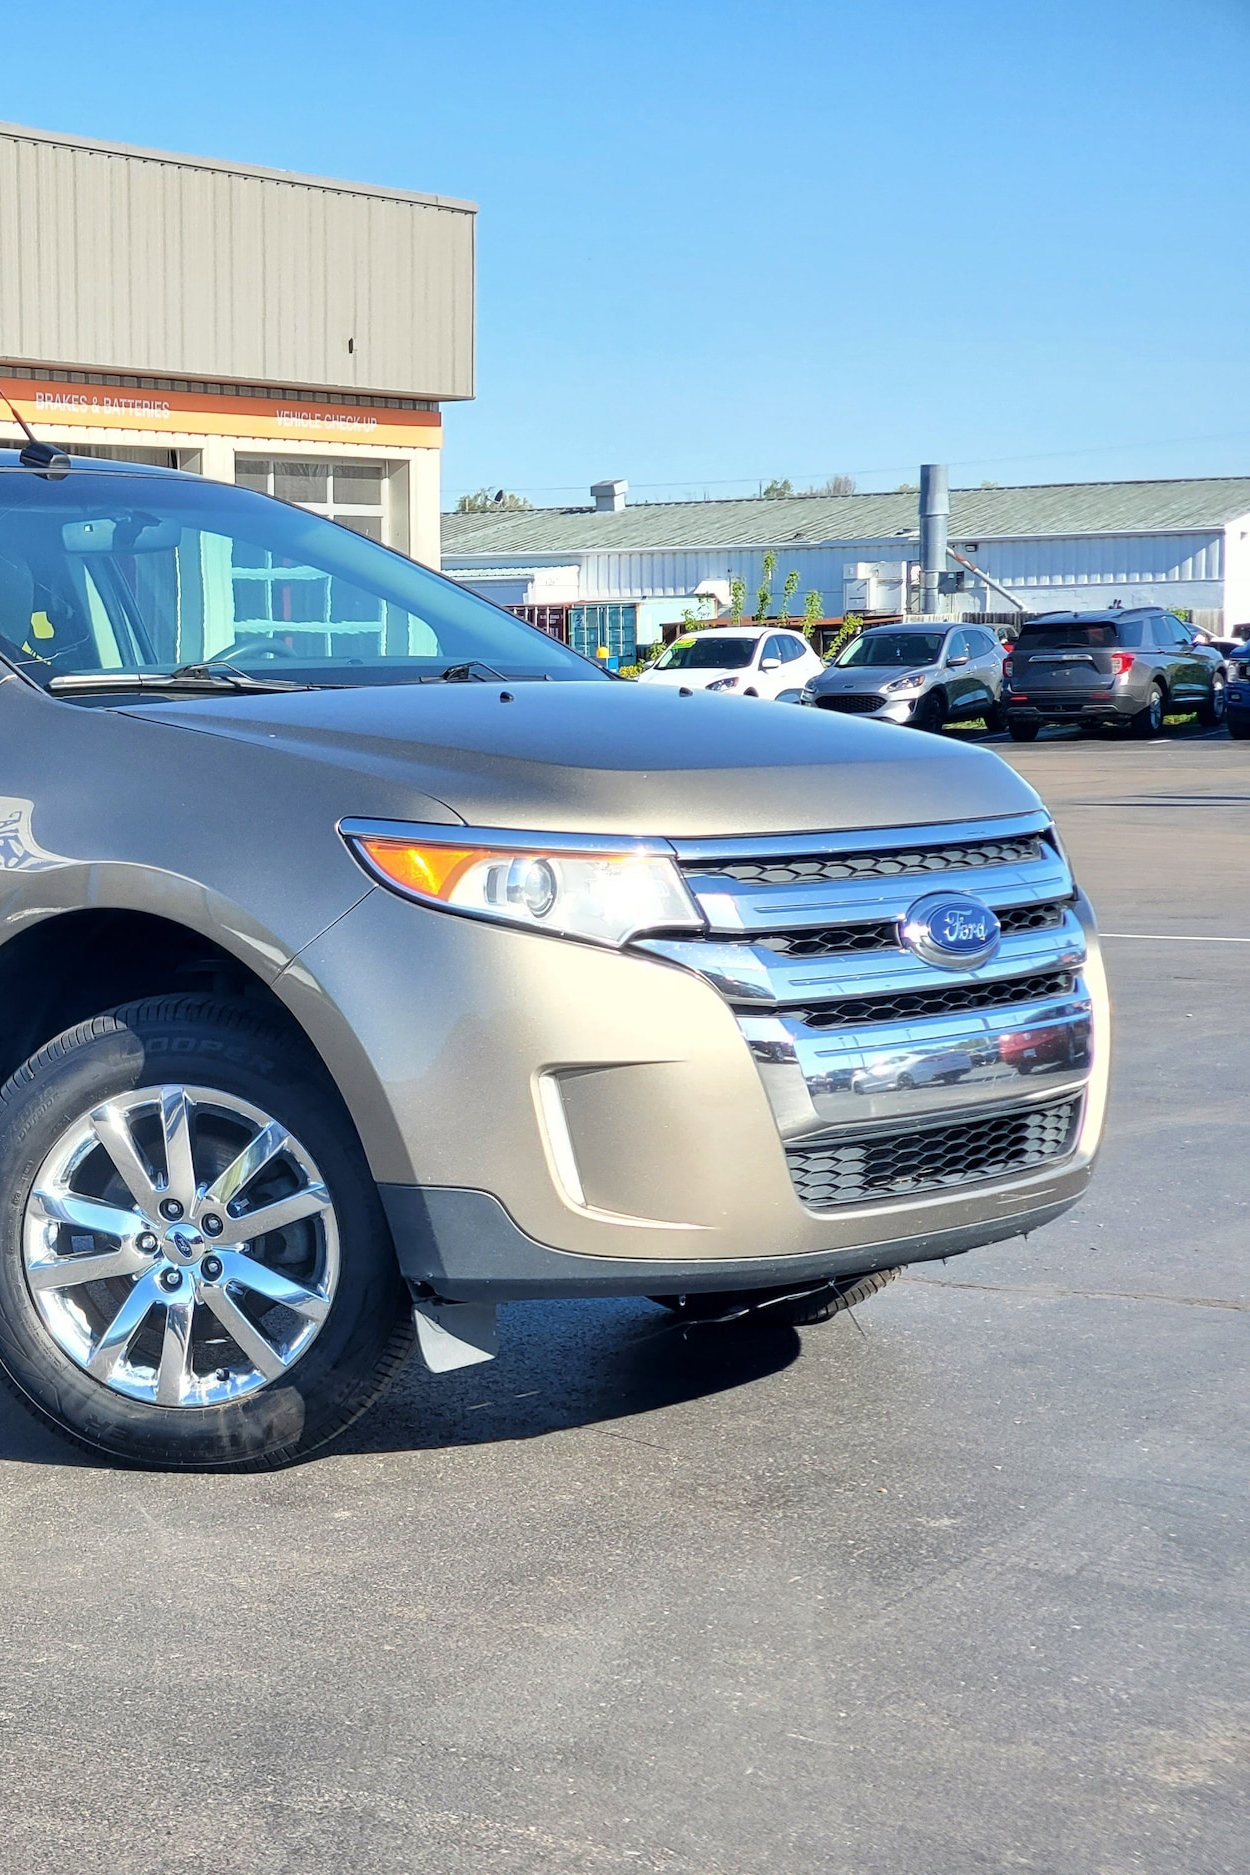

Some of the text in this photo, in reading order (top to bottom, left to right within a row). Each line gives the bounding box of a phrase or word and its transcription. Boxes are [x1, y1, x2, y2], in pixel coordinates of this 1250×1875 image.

[35, 391, 170, 419] BRAKES & BATTERIES
[276, 409, 377, 433] VEHICLE CHECK-UP
[943, 909, 988, 942] Ford
